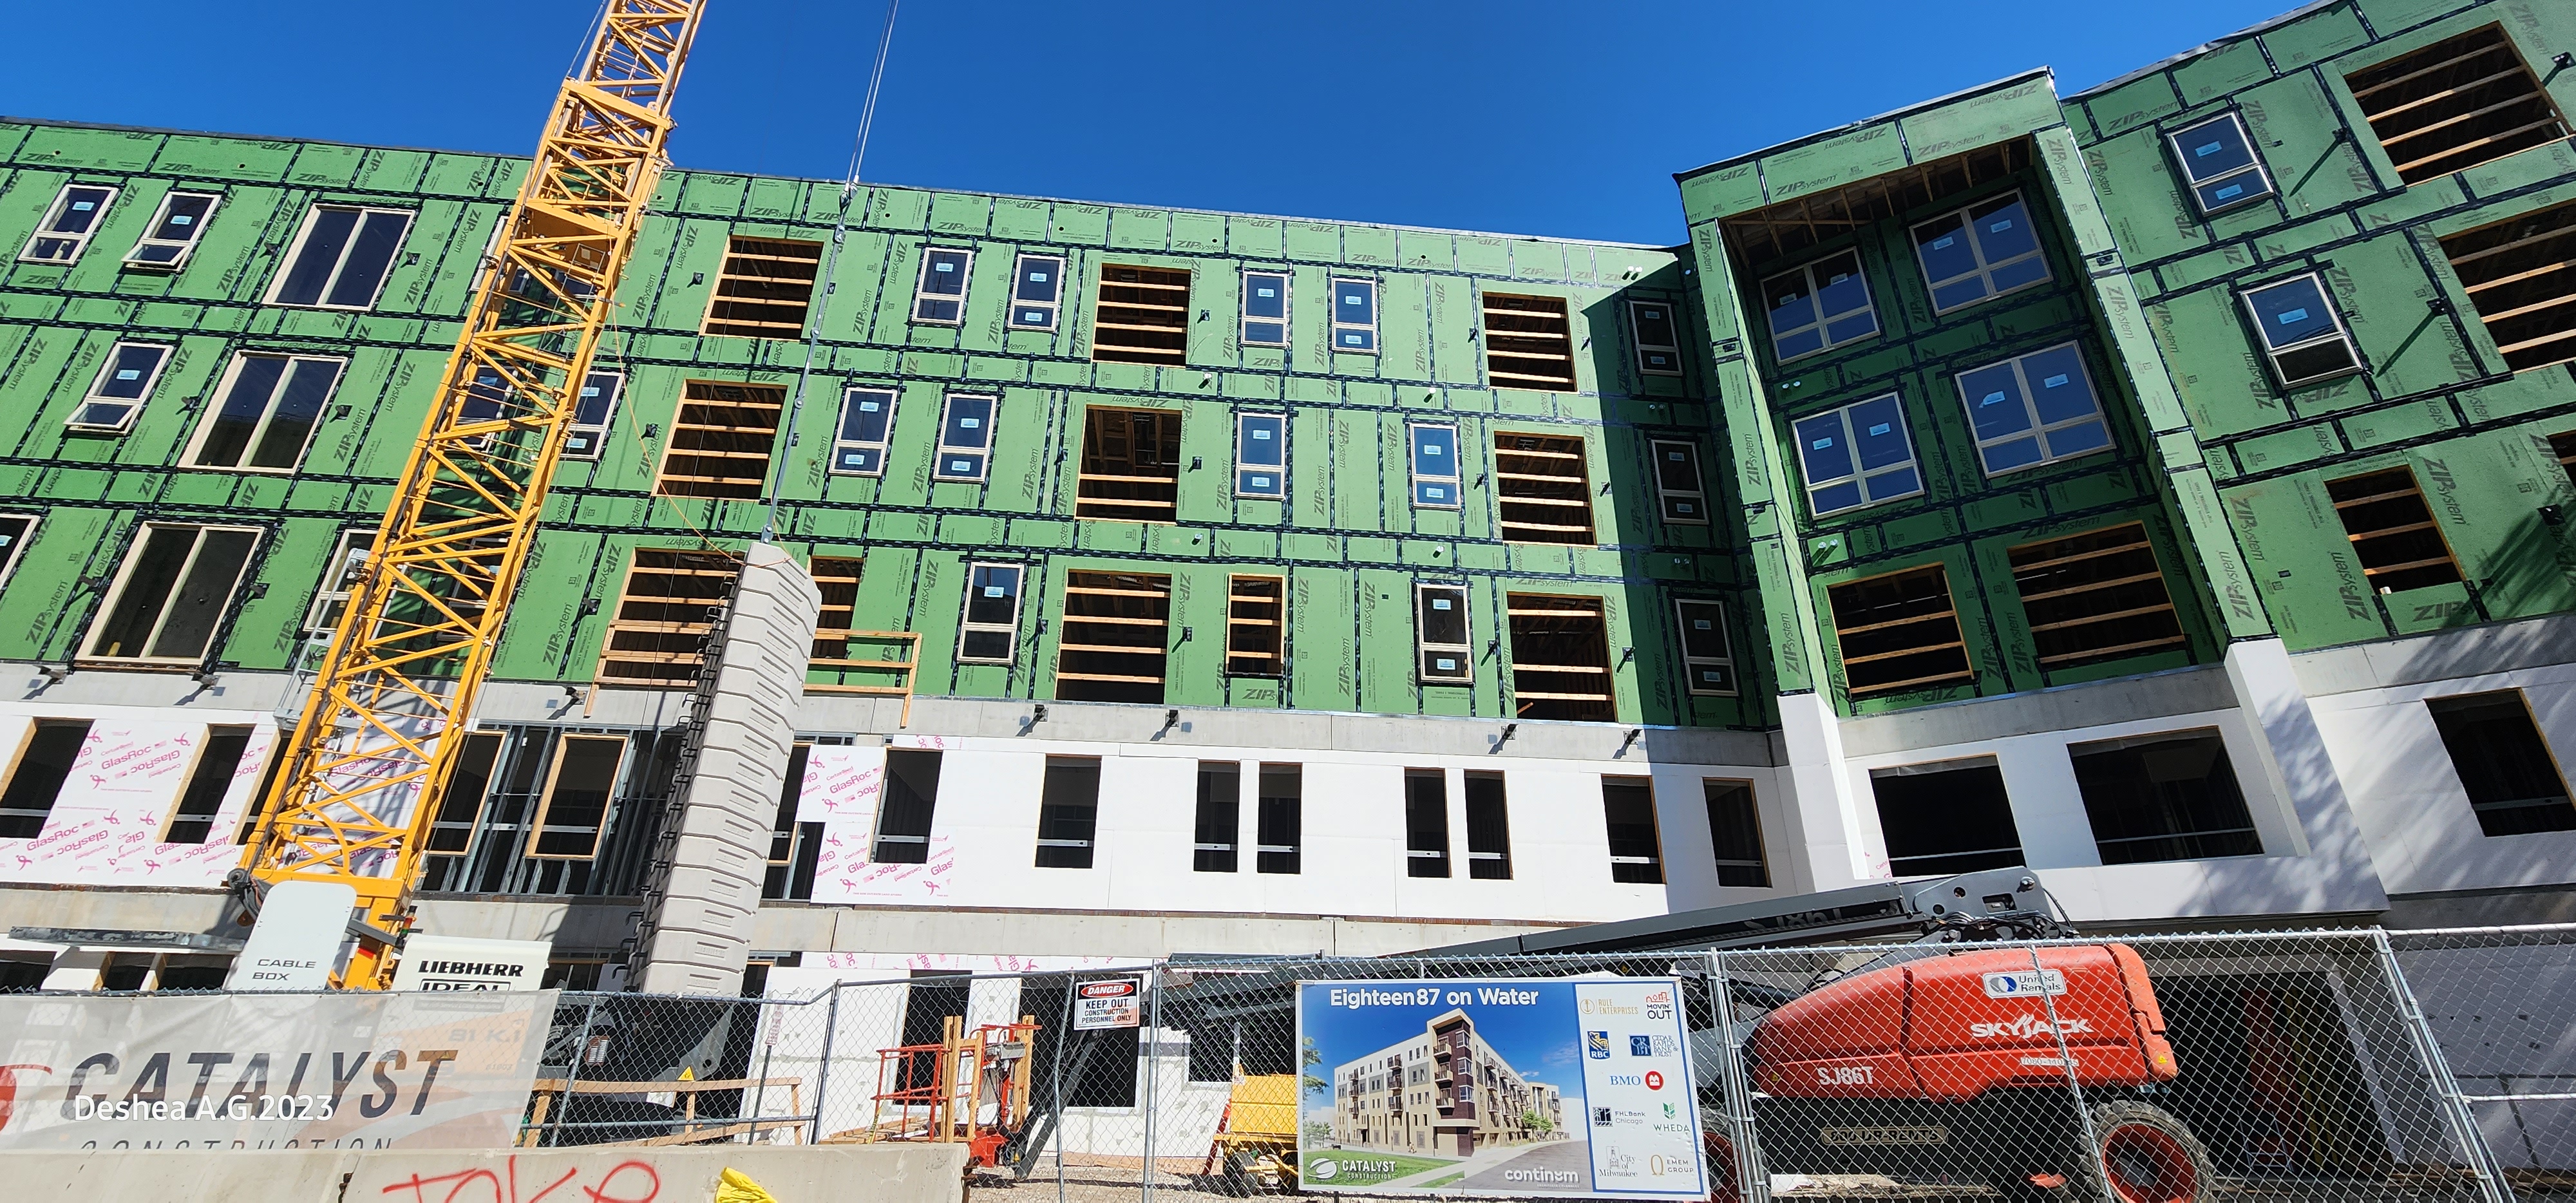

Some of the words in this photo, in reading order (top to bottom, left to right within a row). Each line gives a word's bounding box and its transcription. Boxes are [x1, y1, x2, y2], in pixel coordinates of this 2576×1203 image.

[829, 771, 871, 794] GlasRoc
[258, 959, 316, 968] CABLE
[418, 960, 524, 977] LIEBHERR
[2019, 974, 2055, 983] Unied
[1087, 985, 1126, 995] DANGER
[2021, 983, 2061, 992] Renals
[1446, 991, 1472, 1005] on
[1477, 987, 1539, 1005] Water
[1086, 999, 1108, 1009] KEEP
[1111, 998, 1128, 1008] OUT
[1084, 1008, 1129, 1016] CONSTRUCTION
[1647, 1010, 1672, 1019] OUT
[1971, 1014, 2094, 1039] SKYJACK
[1610, 1075, 1641, 1086] BMO
[1817, 1066, 1874, 1085] SJ86T
[60, 1048, 459, 1119] CATALYST
[1621, 1155, 1636, 1164] City
[1342, 1160, 1396, 1172] CATALYST
[1599, 1169, 1638, 1177] Milwaukee
